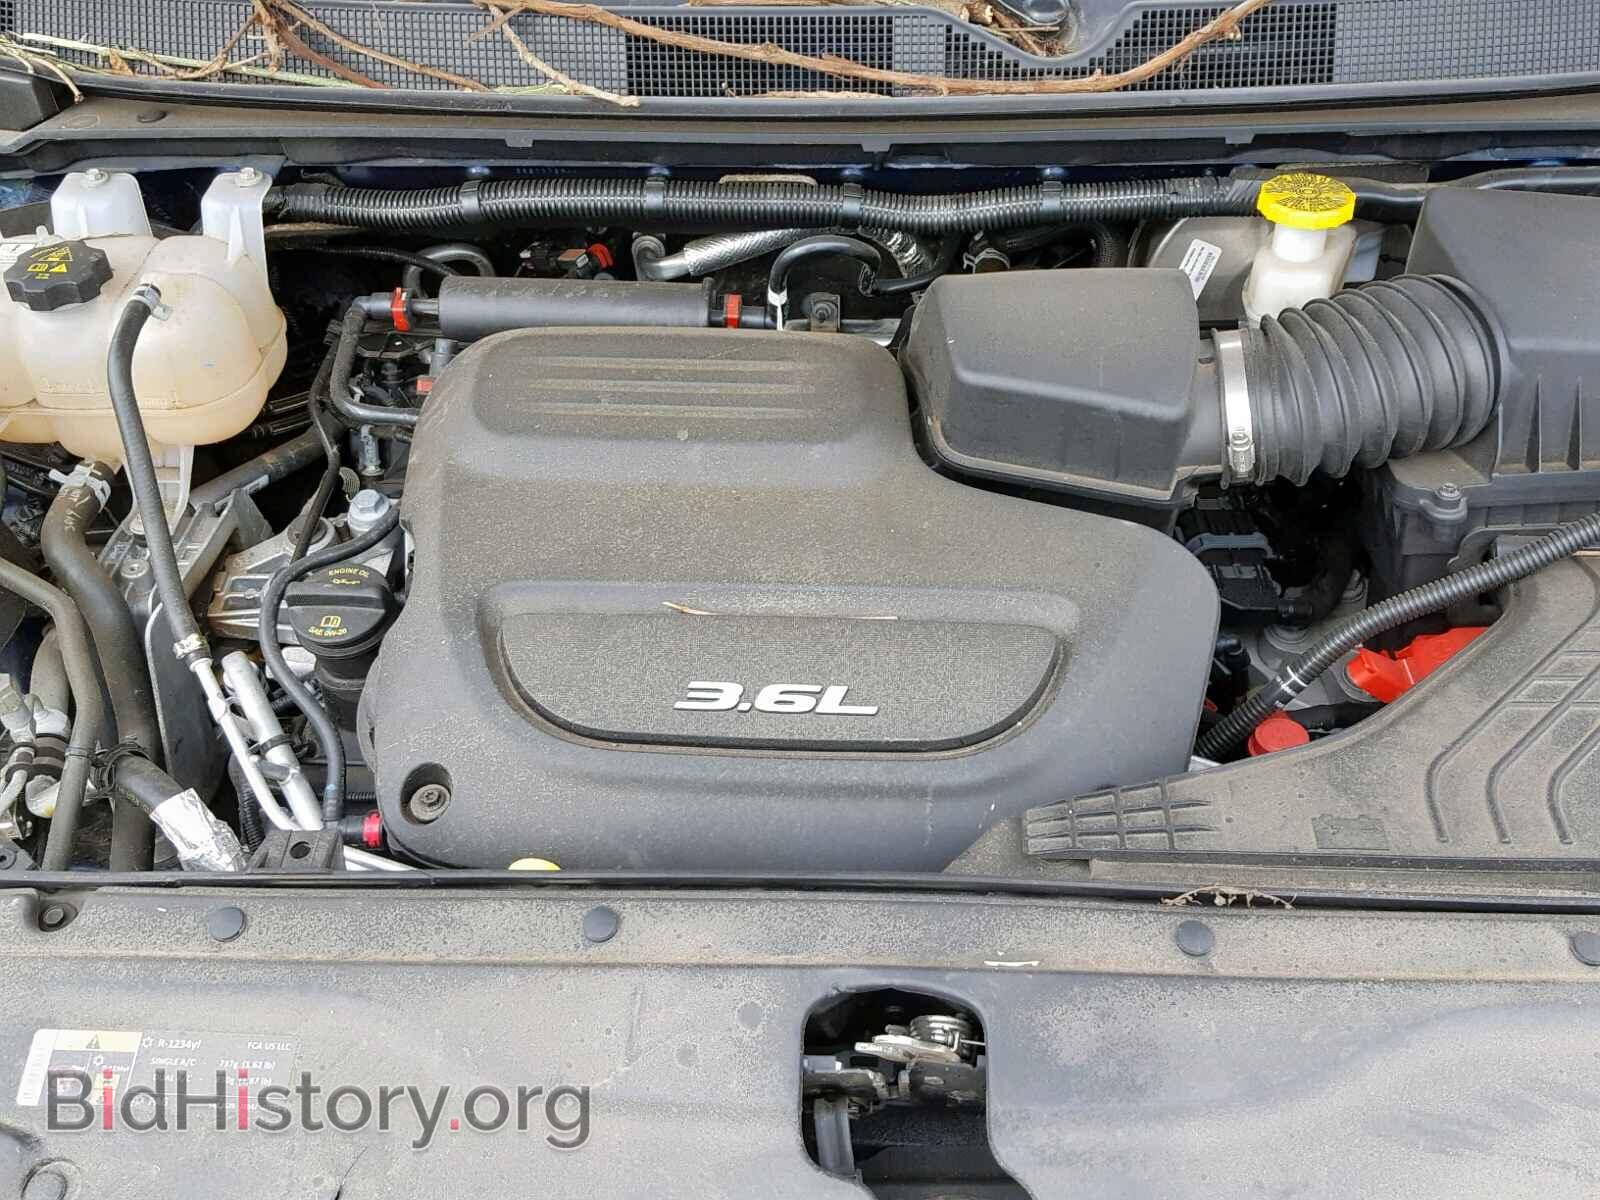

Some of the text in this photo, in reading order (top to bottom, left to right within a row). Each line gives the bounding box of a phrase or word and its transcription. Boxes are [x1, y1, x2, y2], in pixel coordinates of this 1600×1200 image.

[329, 567, 359, 576] ENGINE
[673, 681, 880, 716] 3.6L
[247, 1041, 263, 1050] FCA
